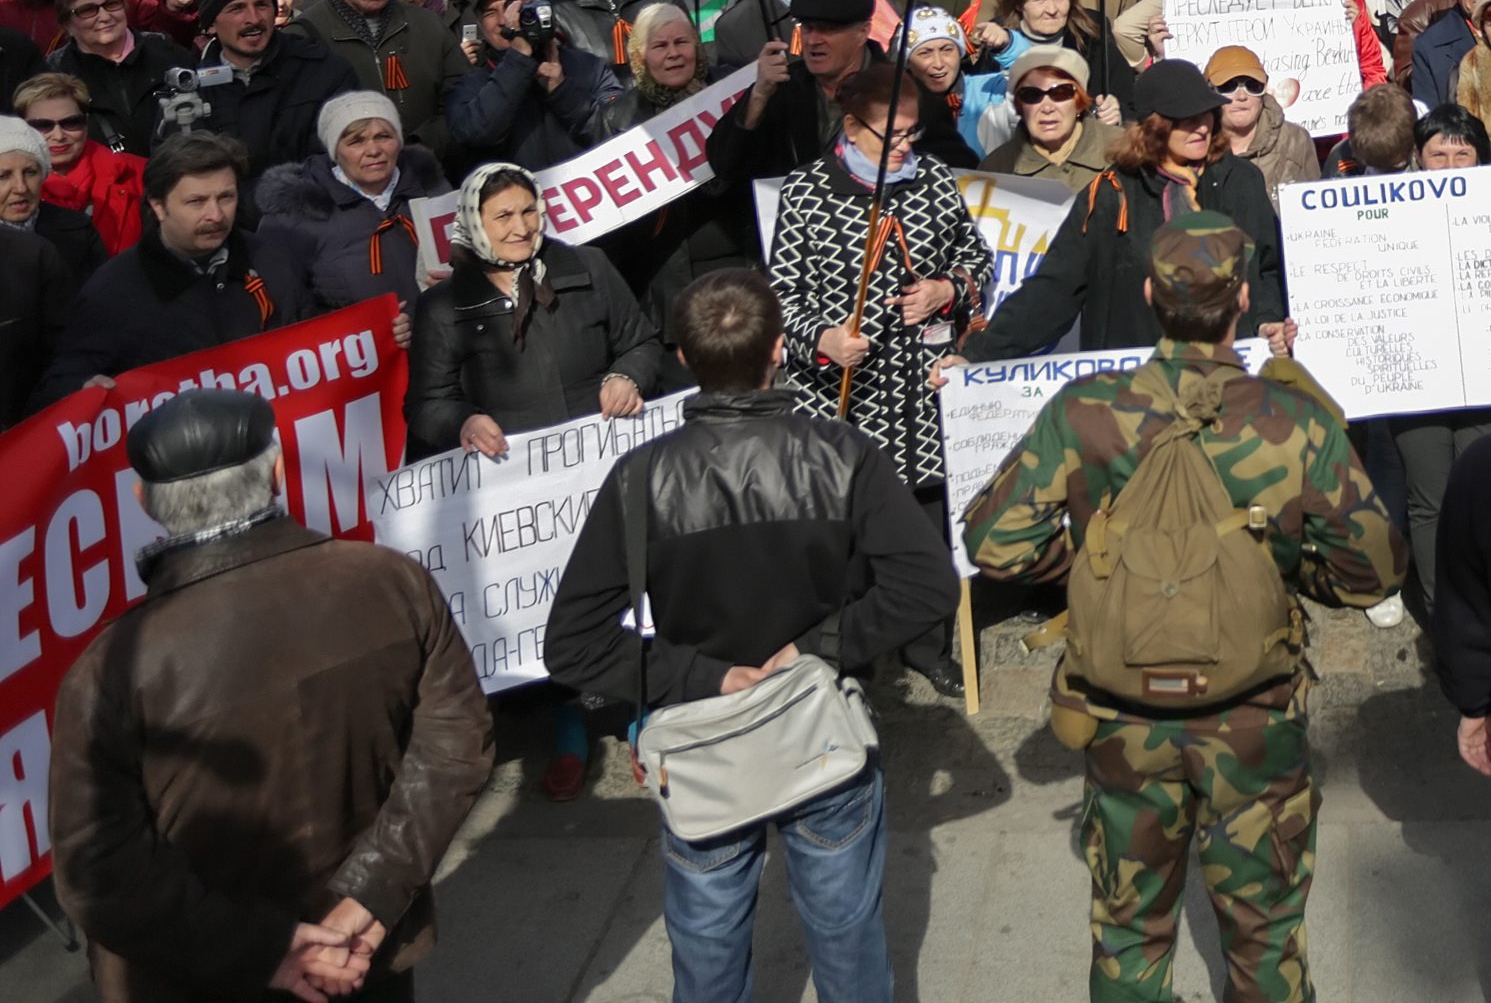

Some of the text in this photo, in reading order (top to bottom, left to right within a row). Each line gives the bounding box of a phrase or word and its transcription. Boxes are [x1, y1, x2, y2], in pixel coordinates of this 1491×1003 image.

[1301, 176, 1467, 210] COULIKOVO
[1357, 208, 1389, 220] POUR
[1454, 216, 1468, 227] LA
[1290, 228, 1337, 242] UKRAINE
[1378, 240, 1420, 253] UNIQUE
[1457, 249, 1478, 262] LES
[1293, 259, 1367, 278] LE RESPECT
[1459, 260, 1471, 271] LA
[1336, 265, 1431, 283] DE DROITS CIVILS
[1459, 271, 1471, 280] LA
[1360, 274, 1438, 290] ET LA LIBERTE
[1460, 281, 1472, 291] LA
[1296, 289, 1438, 312] LA CROISSANCE ECONOMIQUE
[1298, 307, 1408, 327] LA LOI DE LA JUSTICE
[1299, 324, 1385, 342] LA CONSERVATION
[1348, 332, 1415, 347] DES VALEURS
[1345, 342, 1413, 357] CULTURELLES
[1355, 351, 1421, 366] HISTORIQUES
[1367, 359, 1438, 375] SPIRITUELLES
[1351, 371, 1415, 387] DU PEUPLE
[1020, 386, 1044, 398] ЗА
[968, 407, 1041, 422] ФЕДЕРАТИ
[952, 430, 1025, 452] СОБЛЮДЕНИ
[377, 449, 482, 515] ХВАТИТ
[483, 567, 563, 619] СЛУЖ
